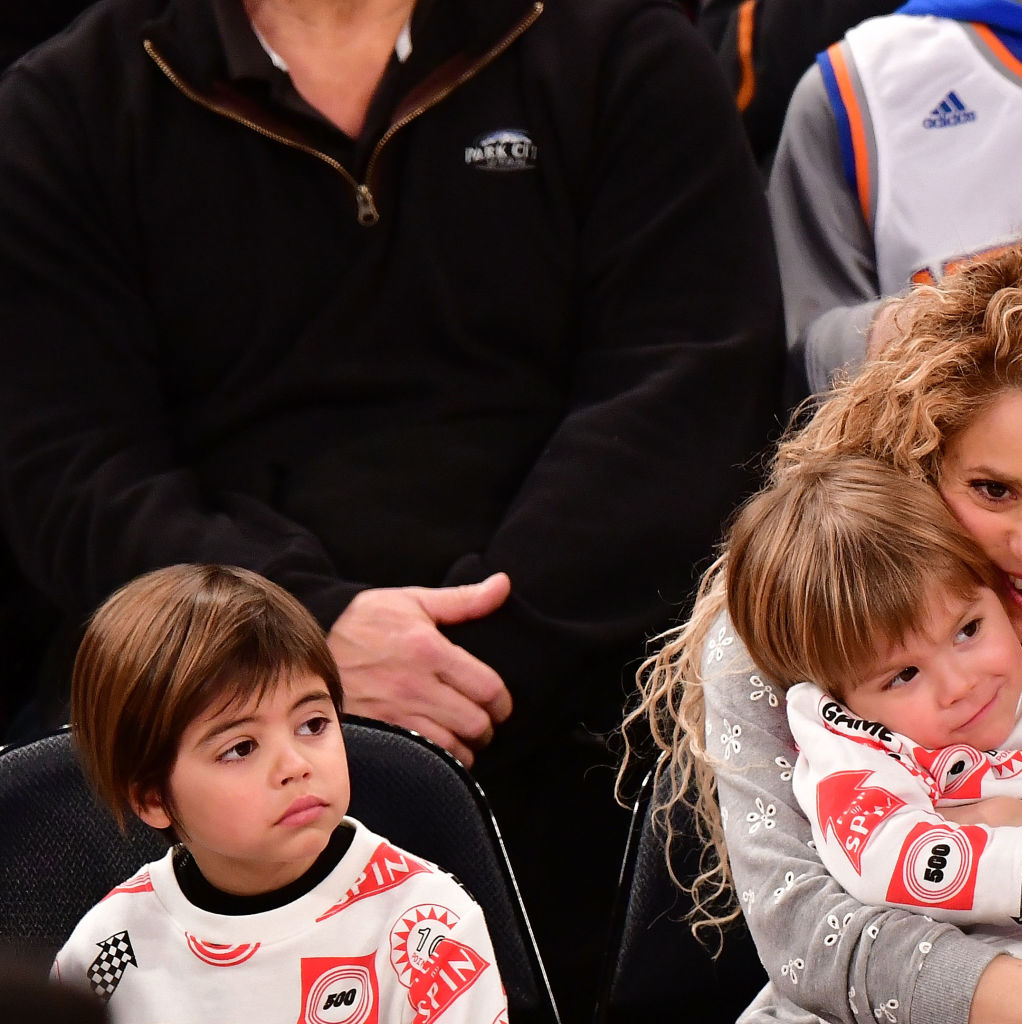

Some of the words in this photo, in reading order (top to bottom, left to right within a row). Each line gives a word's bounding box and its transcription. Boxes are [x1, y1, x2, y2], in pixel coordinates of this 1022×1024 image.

[465, 142, 509, 165] PARK
[923, 843, 951, 883] 500
[323, 988, 357, 1011] 500
[418, 948, 477, 1023] SPIN
